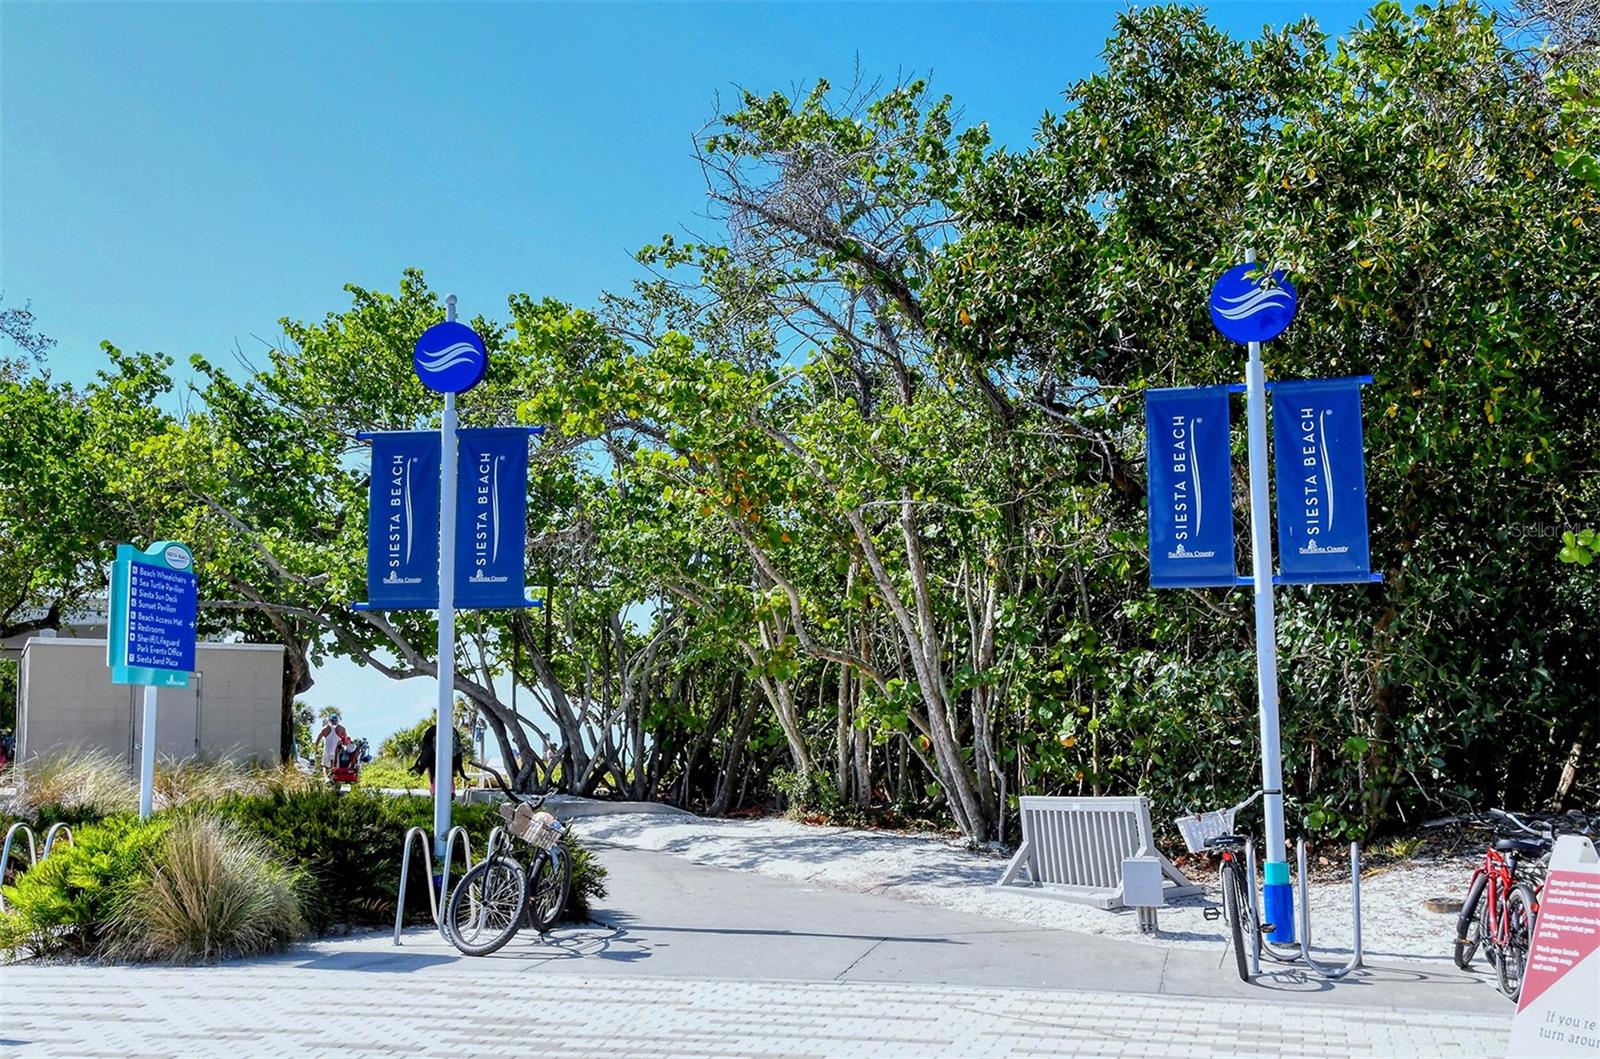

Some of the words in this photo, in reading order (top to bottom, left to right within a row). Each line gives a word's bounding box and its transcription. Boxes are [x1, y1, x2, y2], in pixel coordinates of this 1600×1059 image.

[1172, 415, 1186, 472] BEACH
[1301, 408, 1317, 467] BEACH
[390, 455, 403, 506] BEACH
[478, 453, 491, 505] BEACH
[1174, 480, 1188, 540] SIESTA
[1304, 474, 1320, 535] SIESTA
[389, 513, 400, 567] SIESTA
[476, 512, 487, 566] SIESTA
[1194, 550, 1215, 558] County
[1326, 545, 1349, 554] County
[139, 567, 156, 577] Beach
[156, 571, 187, 584] Wheelchairs
[491, 575, 508, 583] County
[139, 578, 149, 587] Sea
[151, 580, 164, 590] Turtle
[165, 583, 184, 593] Pavilion
[139, 588, 154, 598] Siesta
[155, 592, 164, 600] Sun
[165, 594, 177, 603] Deck
[139, 600, 156, 609] Sunset
[157, 603, 176, 613] Pavilion
[138, 612, 154, 621] Beach
[156, 616, 172, 625] Access
[173, 618, 183, 626] Mat
[137, 623, 165, 634] Restrooms
[137, 644, 148, 653] Park
[150, 645, 167, 655] Events
[167, 648, 182, 657] Office
[136, 654, 152, 663] Siesta
[152, 656, 165, 665] Sand
[165, 658, 178, 666] Plaza
[1546, 1010, 1556, 1023] If
[1540, 1027, 1564, 1041] turn
